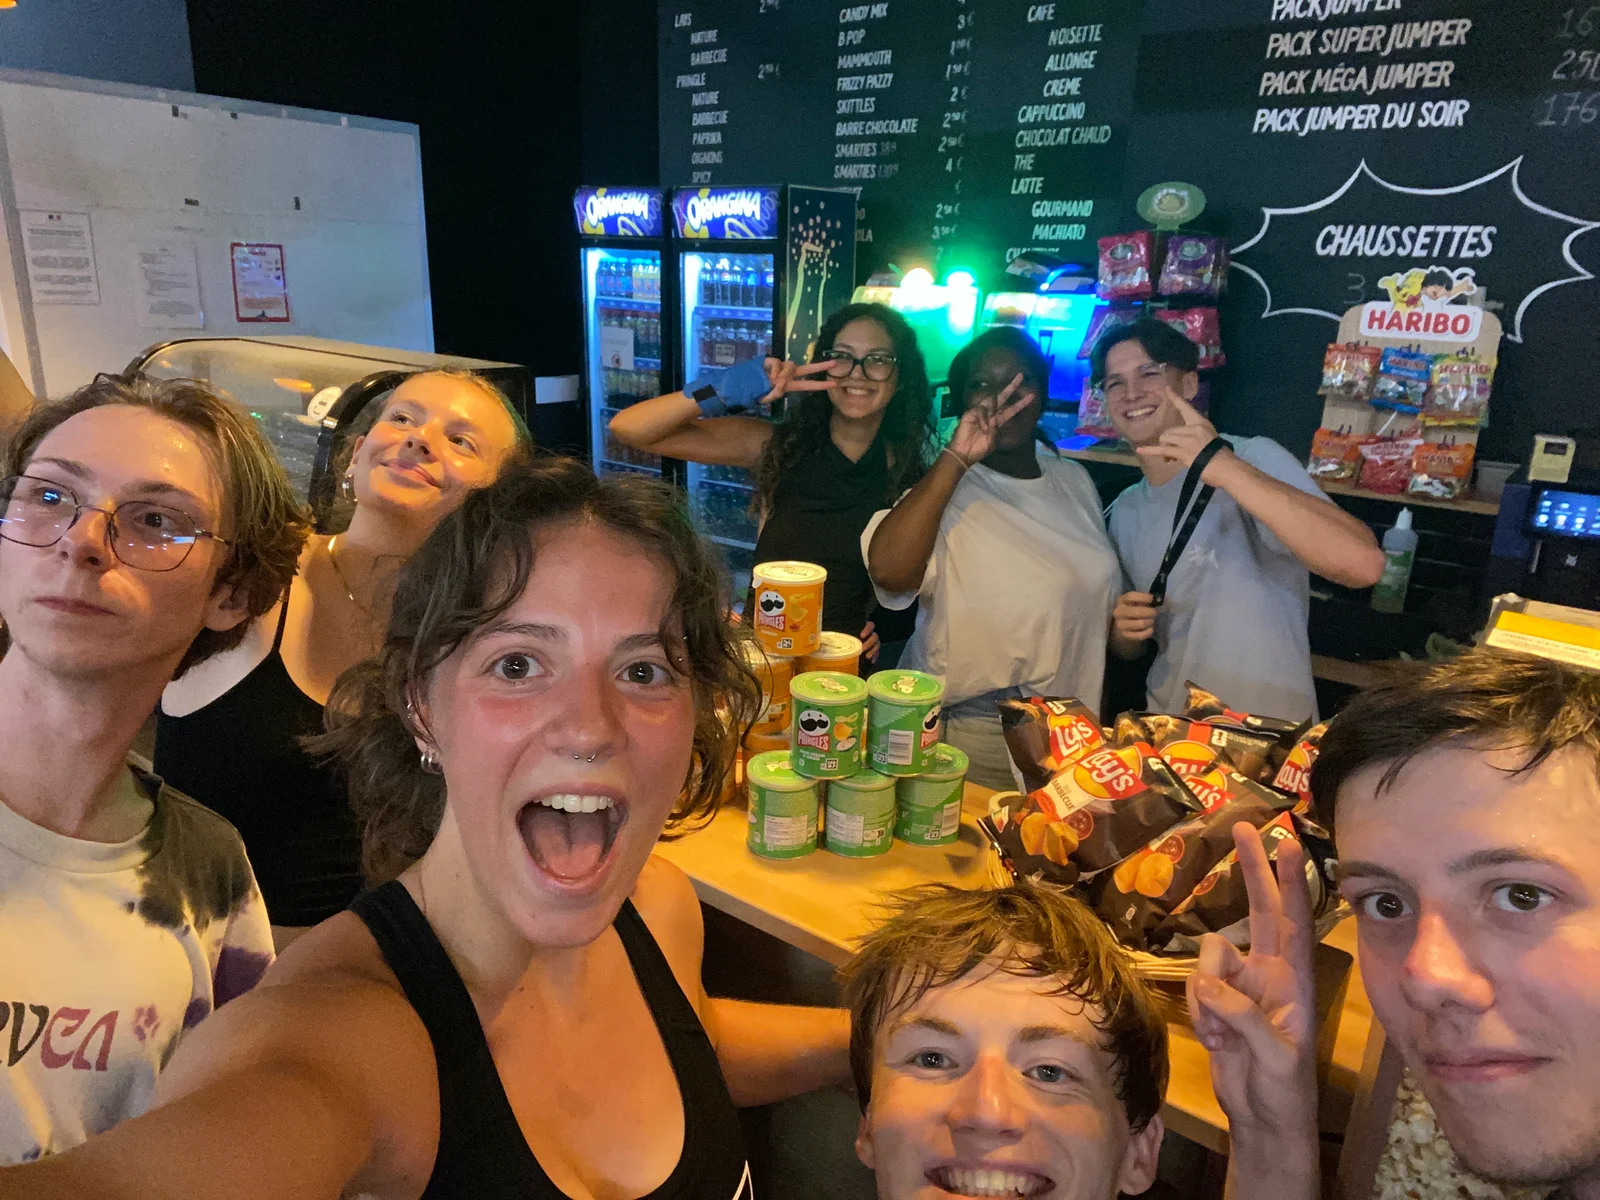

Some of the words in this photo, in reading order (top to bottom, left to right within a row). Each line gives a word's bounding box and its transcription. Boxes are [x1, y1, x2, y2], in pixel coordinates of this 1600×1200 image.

[839, 5, 870, 23] CANDY
[870, 3, 889, 19] MIX
[1027, 3, 1056, 23] CAFE
[690, 29, 718, 45] NATURE
[838, 31, 846, 47] B
[845, 28, 866, 46] POP
[1048, 23, 1103, 46] NOISETTE
[1266, 29, 1317, 59] PACK
[1318, 25, 1387, 54] SUPER
[1380, 18, 1472, 57] JUMPER
[690, 48, 728, 66] BARBECUE
[837, 49, 892, 70] MAMMOUTH
[1044, 50, 1098, 72] ALLONGE
[676, 72, 706, 88] PRINGLE
[836, 76, 866, 91] FRIZZY
[865, 73, 894, 89] PAZZY
[1042, 77, 1082, 97] CREME
[1259, 69, 1311, 97] PACK
[1310, 62, 1368, 94] MÉGA
[1365, 60, 1455, 96] JUMPER
[692, 91, 719, 106] NATURE
[836, 97, 876, 114] SKITTLES
[692, 110, 729, 126] BARBECUE
[1017, 101, 1086, 124] CAPPUCCINO
[1252, 107, 1304, 133] PACK
[1298, 104, 1380, 137] JUMPER
[1381, 102, 1416, 129] DU
[1417, 99, 1470, 128] SOIR
[835, 121, 866, 136] BARRE
[865, 118, 919, 135] CHOCOLATE
[1015, 127, 1072, 149] CHOCOLAT
[1071, 124, 1112, 145] CHAUD
[692, 132, 722, 146] PAPRIKA
[835, 142, 877, 158] SMARTIES
[833, 163, 877, 179] SMARTIES
[1013, 153, 1036, 171] THE
[1010, 176, 1045, 195] LATTE
[586, 190, 650, 228] ORANGINA
[687, 189, 762, 233] ORANGINA
[1031, 199, 1094, 218] GOURMAND
[1031, 223, 1087, 241] MACHIATO
[1315, 224, 1497, 259] CHAUSSETTES
[1367, 309, 1472, 336] HARIBO
[759, 611, 785, 631] PRINGLES
[798, 729, 829, 751] PRINGLES
[1079, 748, 1135, 792] Lay's
[1051, 779, 1076, 812] BARBECUE
